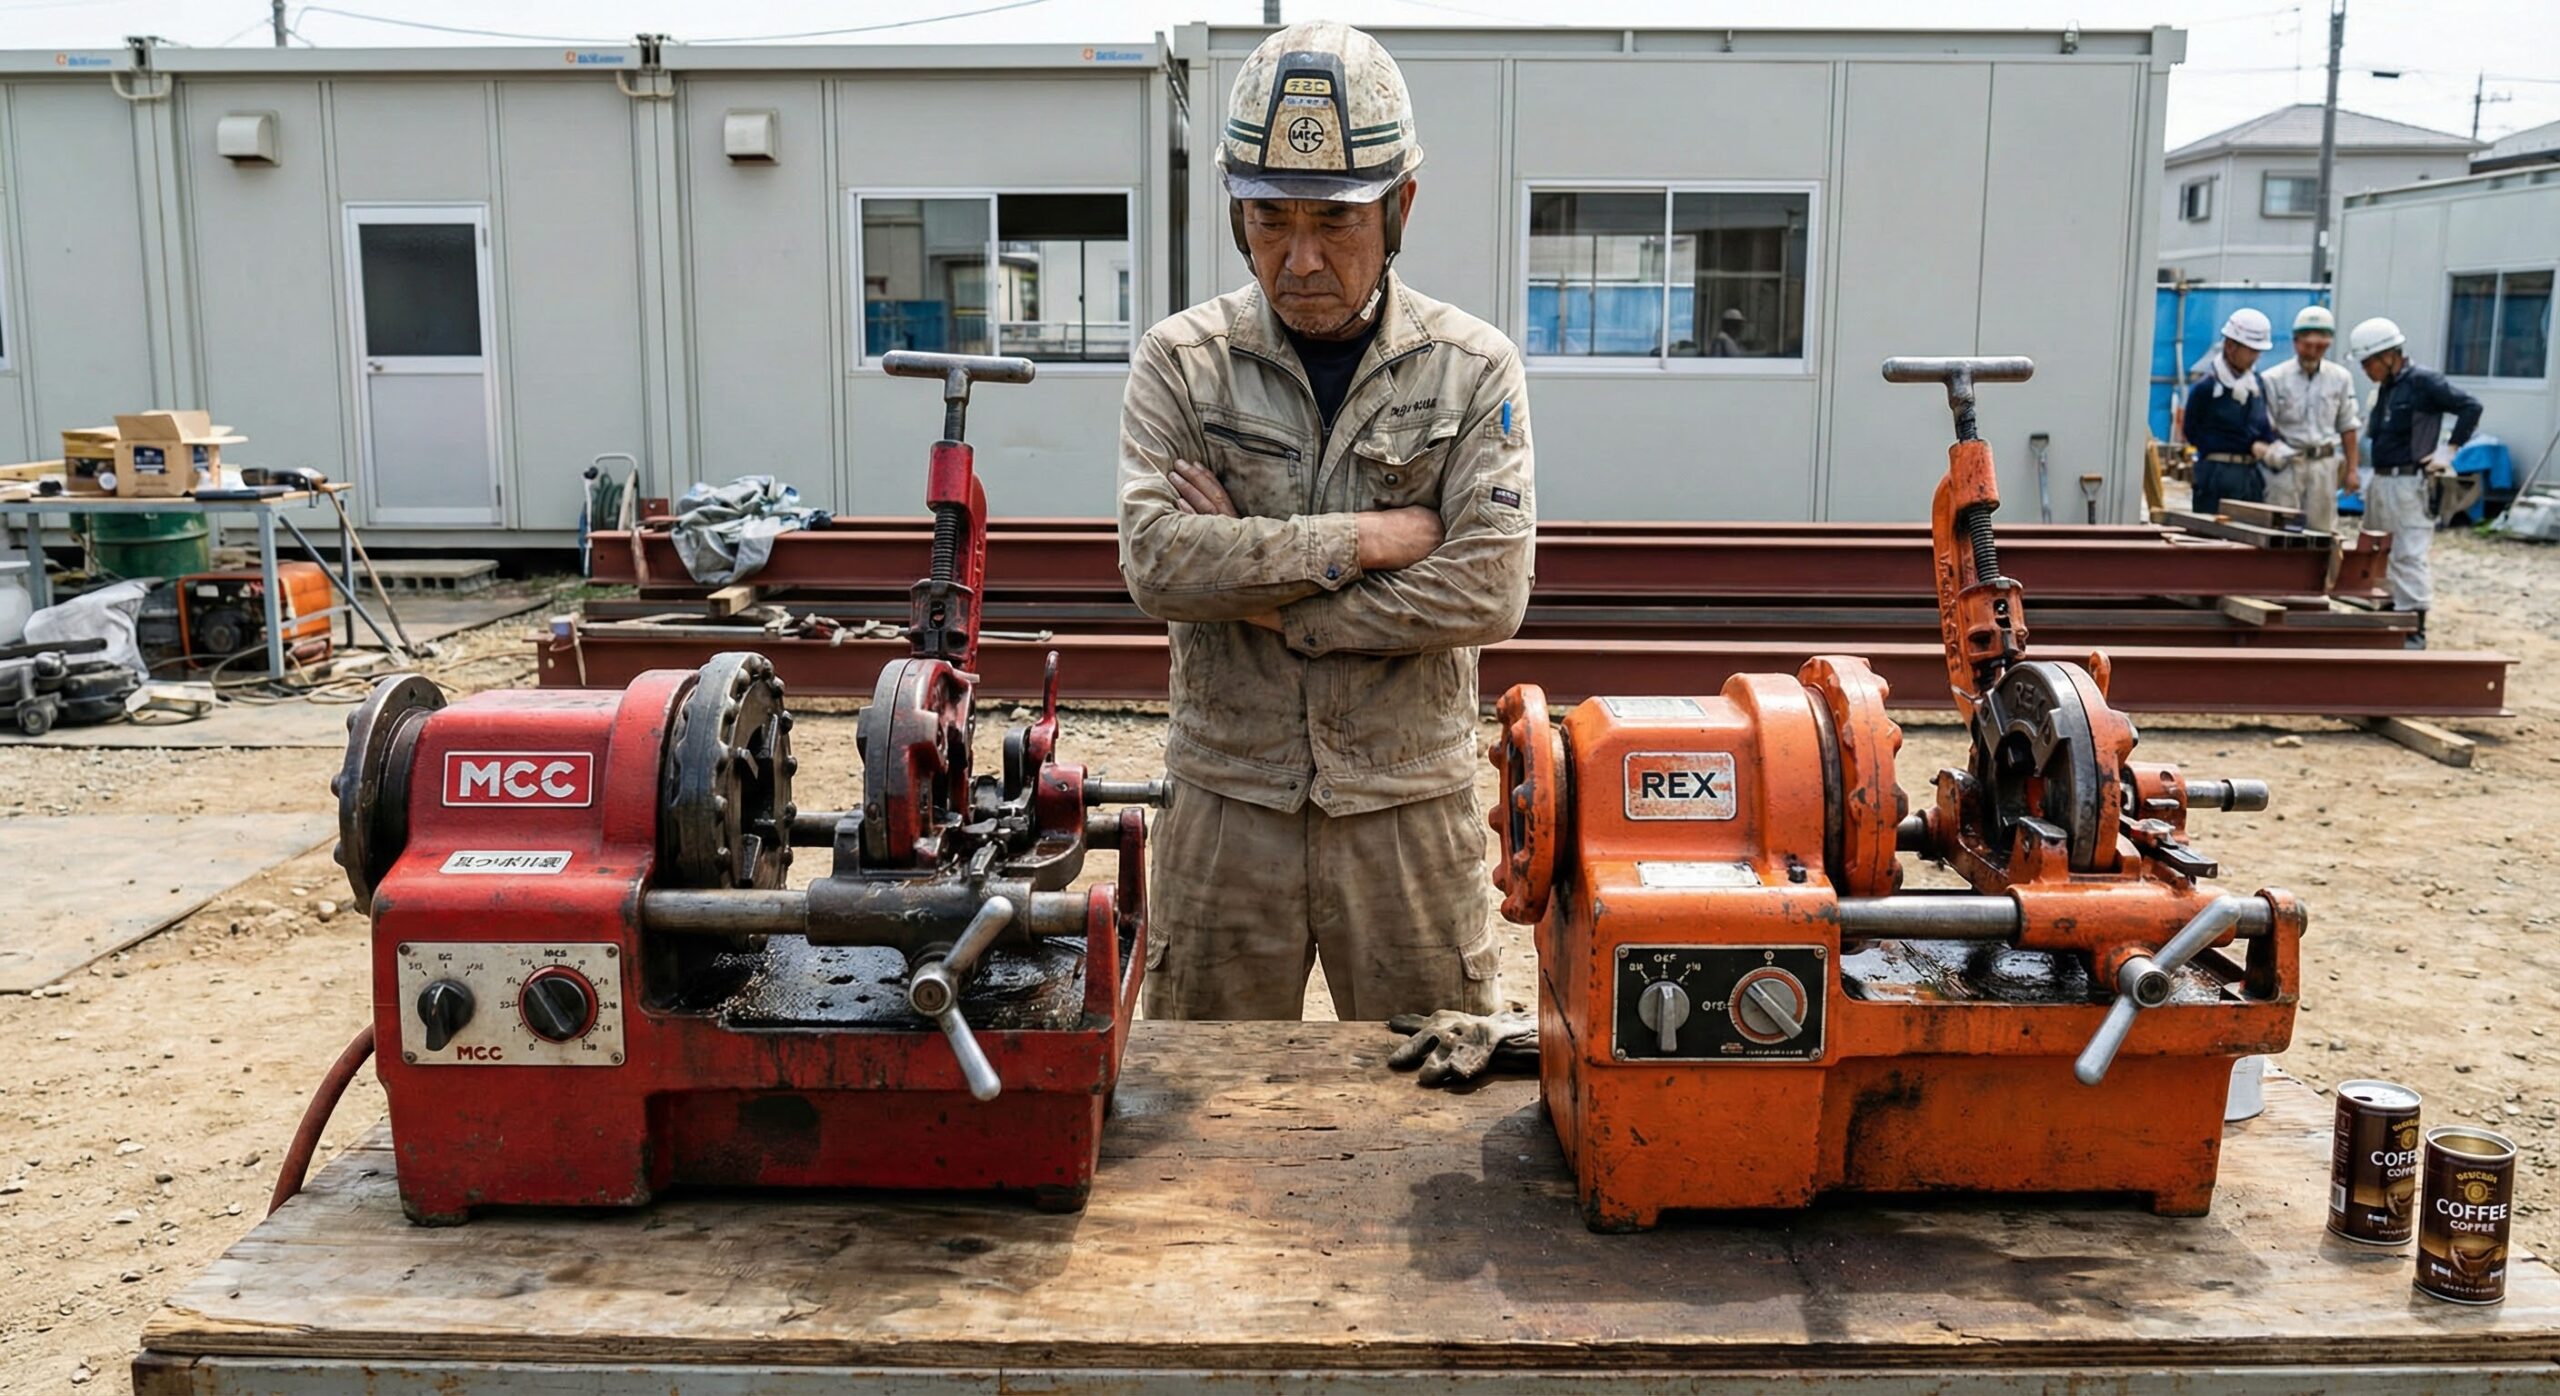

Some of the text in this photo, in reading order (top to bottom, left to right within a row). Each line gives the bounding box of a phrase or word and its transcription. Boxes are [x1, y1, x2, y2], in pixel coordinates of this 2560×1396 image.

[459, 761, 576, 798] MCC
[1641, 772, 1718, 799] REX
[457, 1046, 503, 1061] MCC
[2370, 1150, 2418, 1166] COFF
[2436, 1198, 2508, 1221] COFFEE
